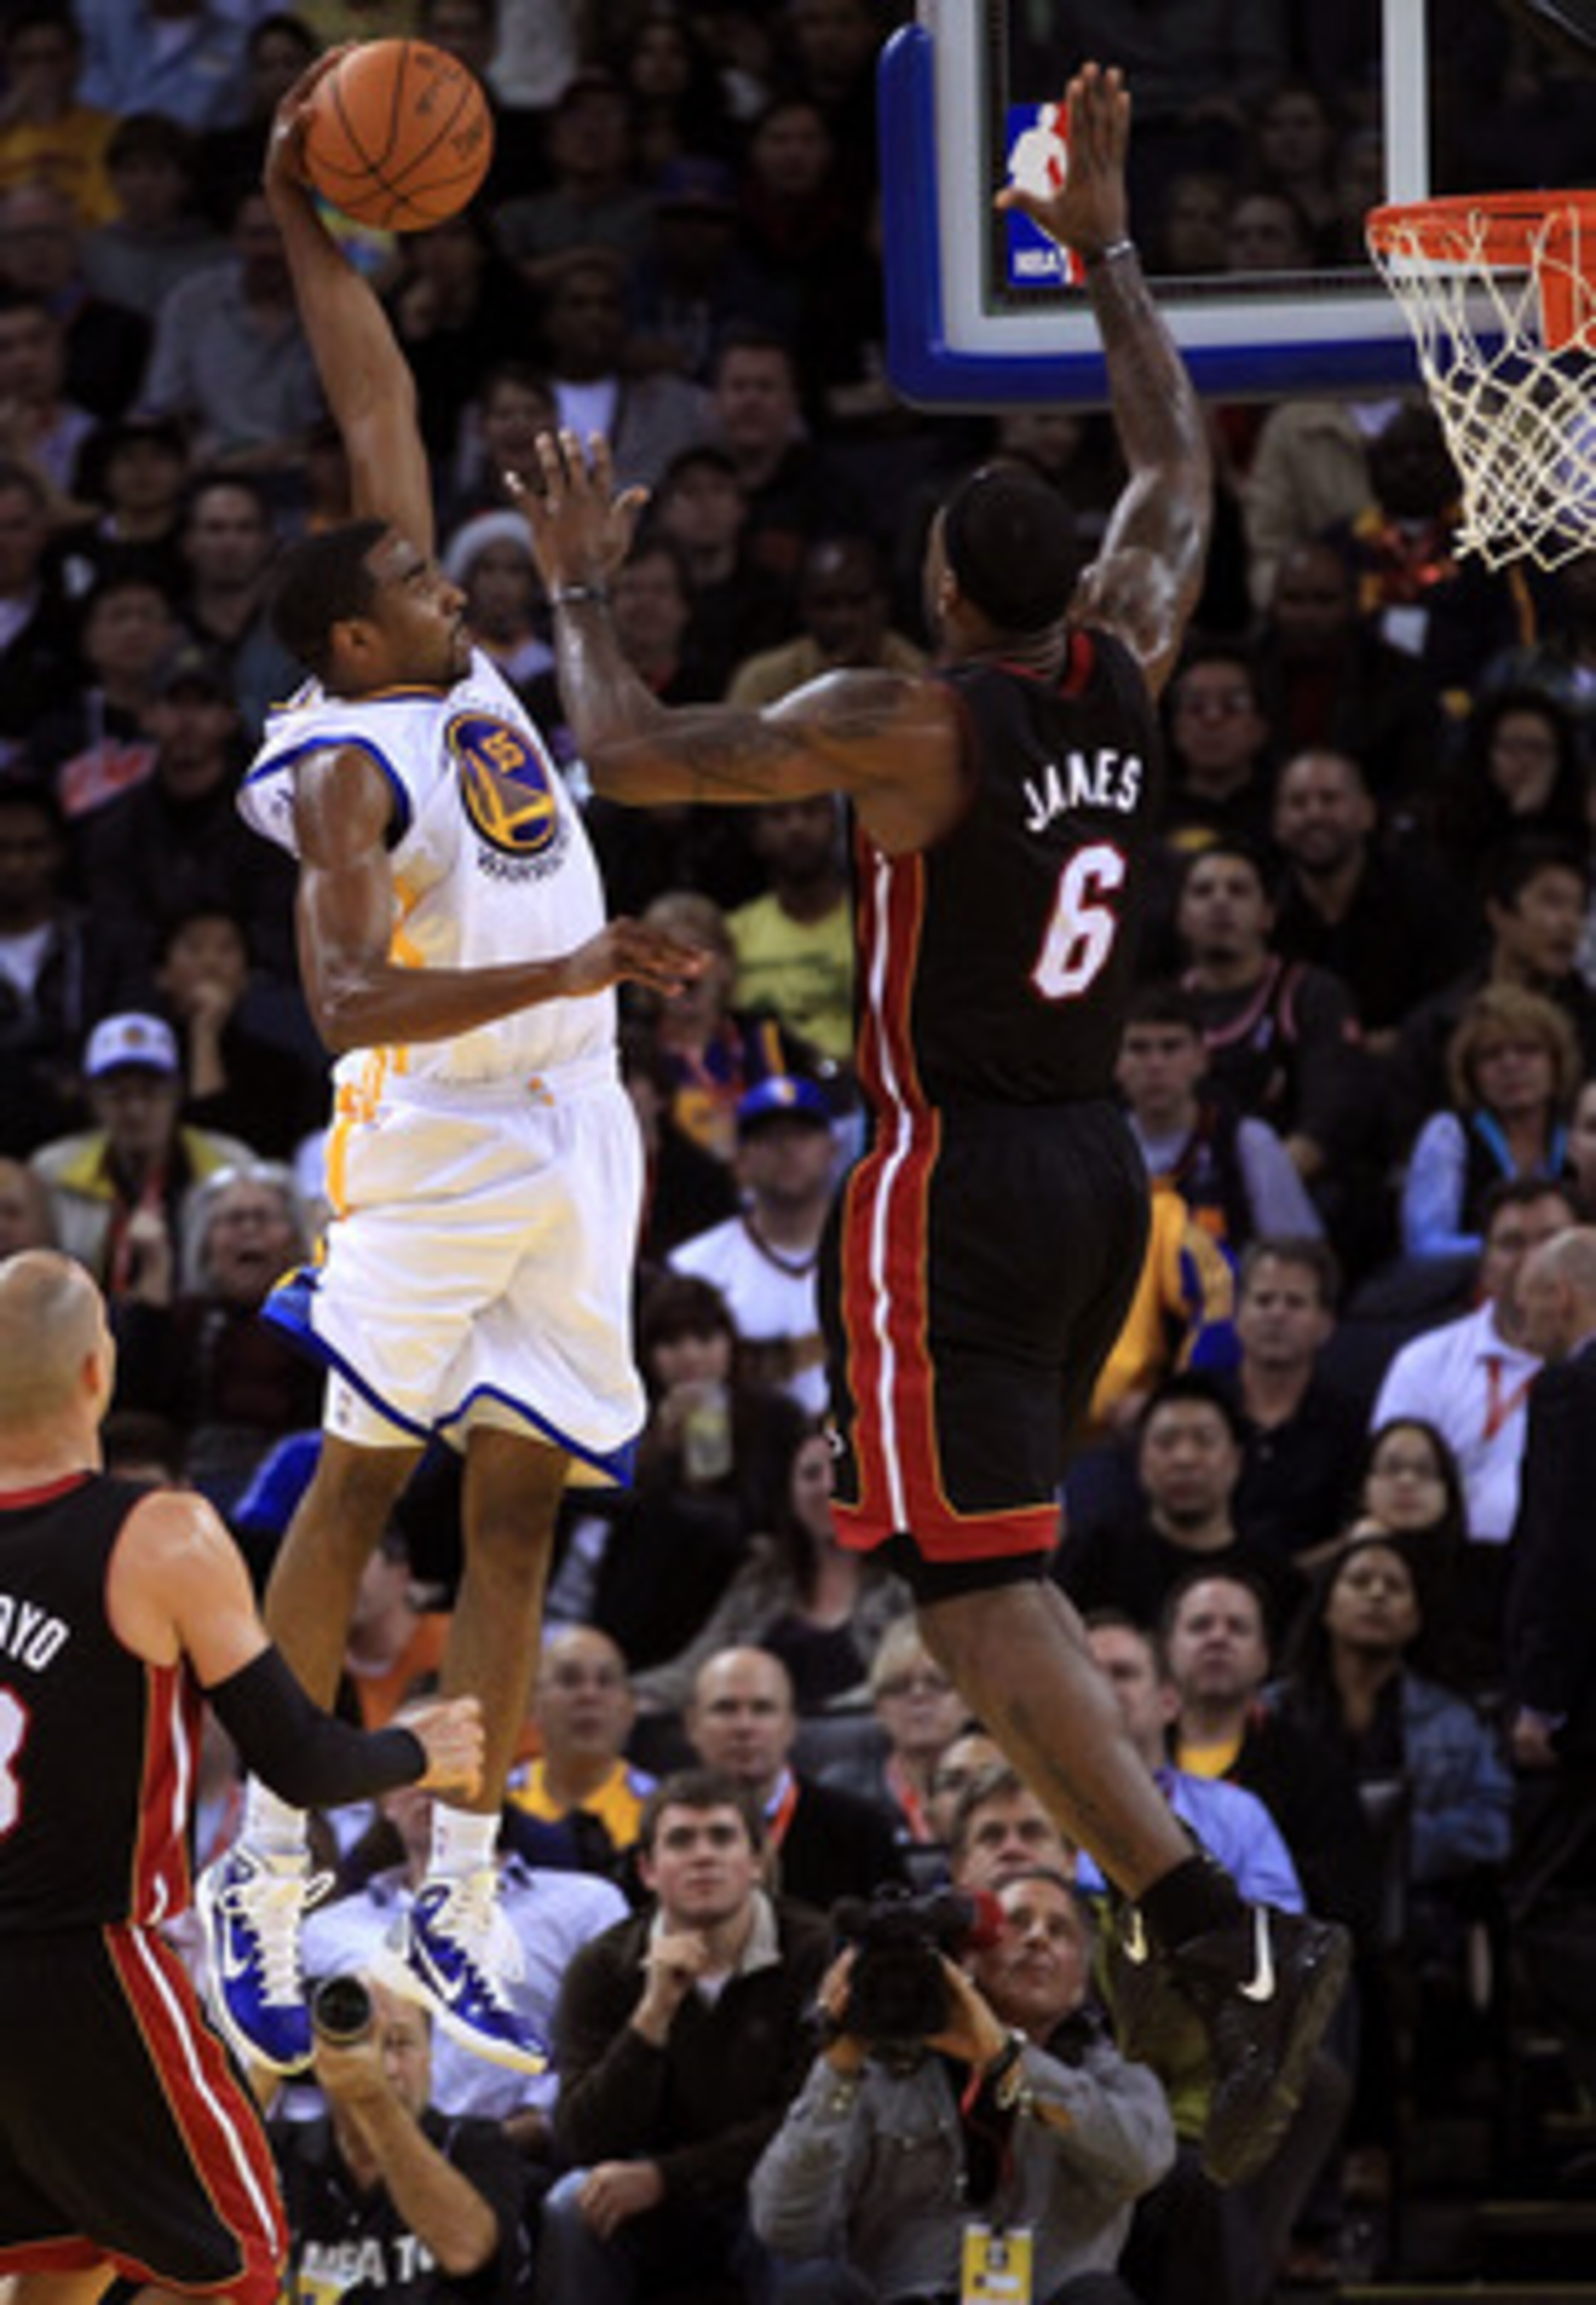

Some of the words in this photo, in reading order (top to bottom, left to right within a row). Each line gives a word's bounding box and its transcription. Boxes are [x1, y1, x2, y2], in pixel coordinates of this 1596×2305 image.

[1014, 249, 1061, 276] NBA
[1024, 747, 1142, 832] JAMES
[1031, 841, 1126, 1001] 6
